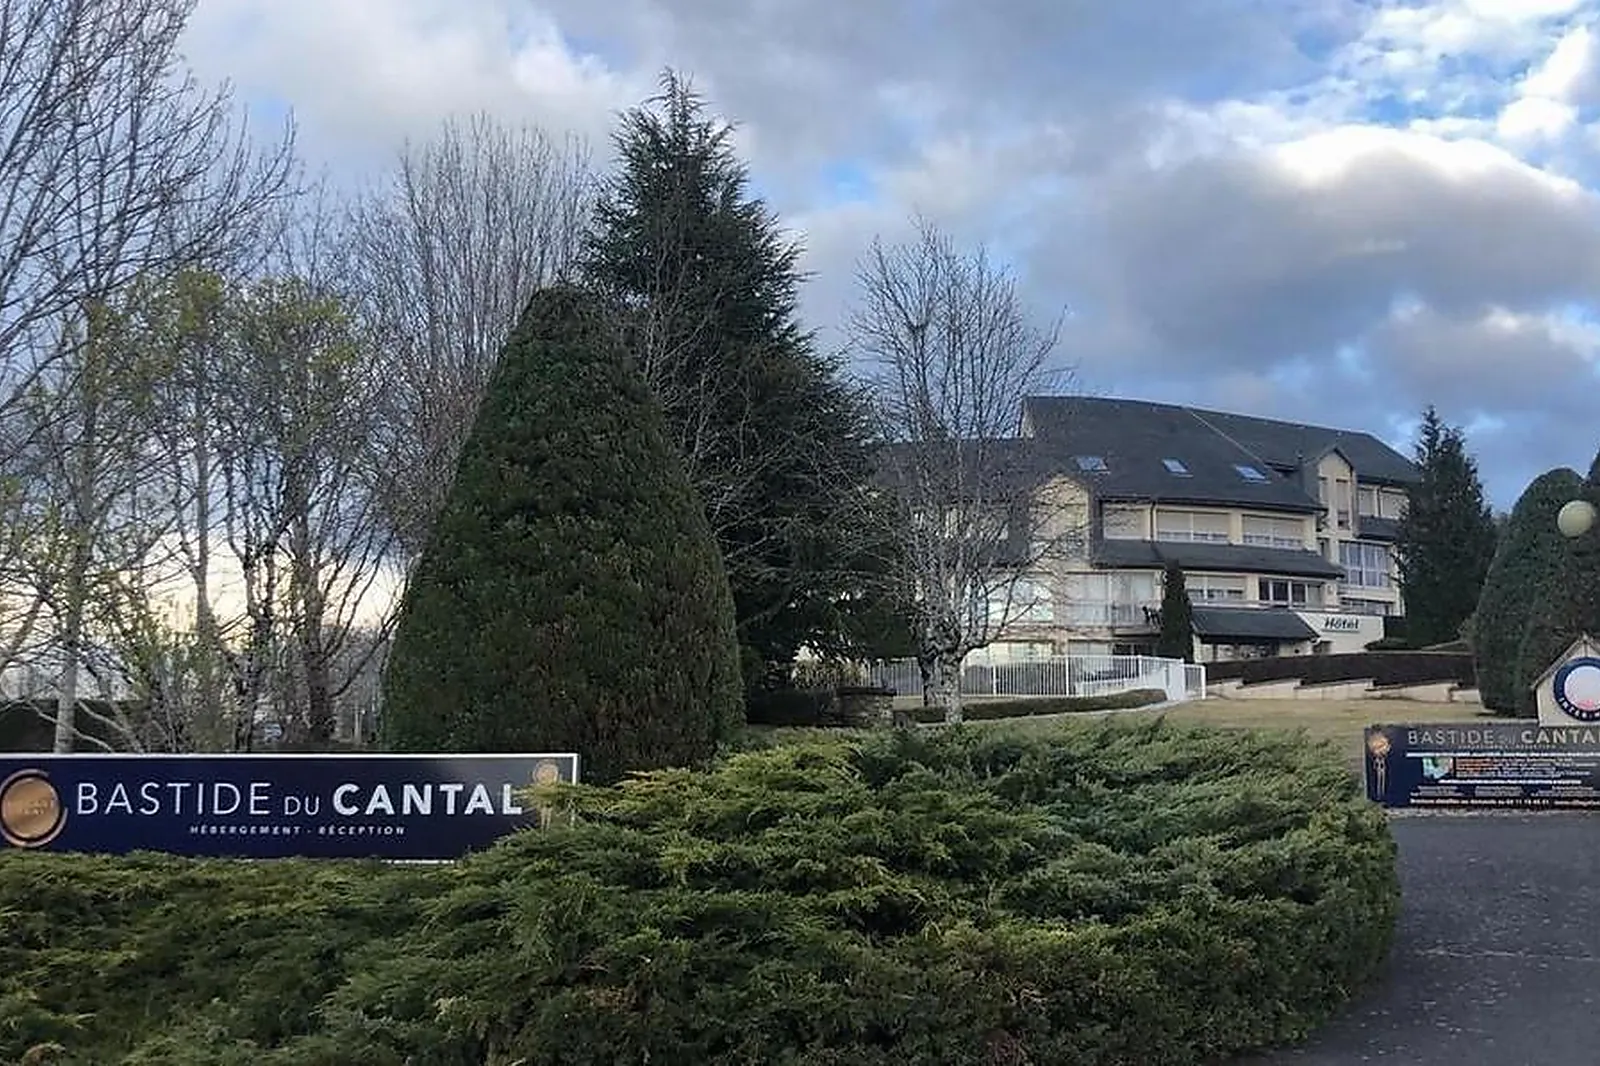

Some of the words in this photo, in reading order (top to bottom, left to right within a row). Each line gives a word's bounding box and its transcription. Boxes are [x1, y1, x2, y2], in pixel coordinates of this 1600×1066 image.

[1407, 729, 1495, 745] BASTIDE
[76, 781, 272, 816] BASTIDE
[284, 795, 321, 816] DU
[333, 783, 524, 816] CANTAL
[190, 824, 302, 836] HÉBERGEMENT
[318, 824, 406, 836] RÉCEPTION
